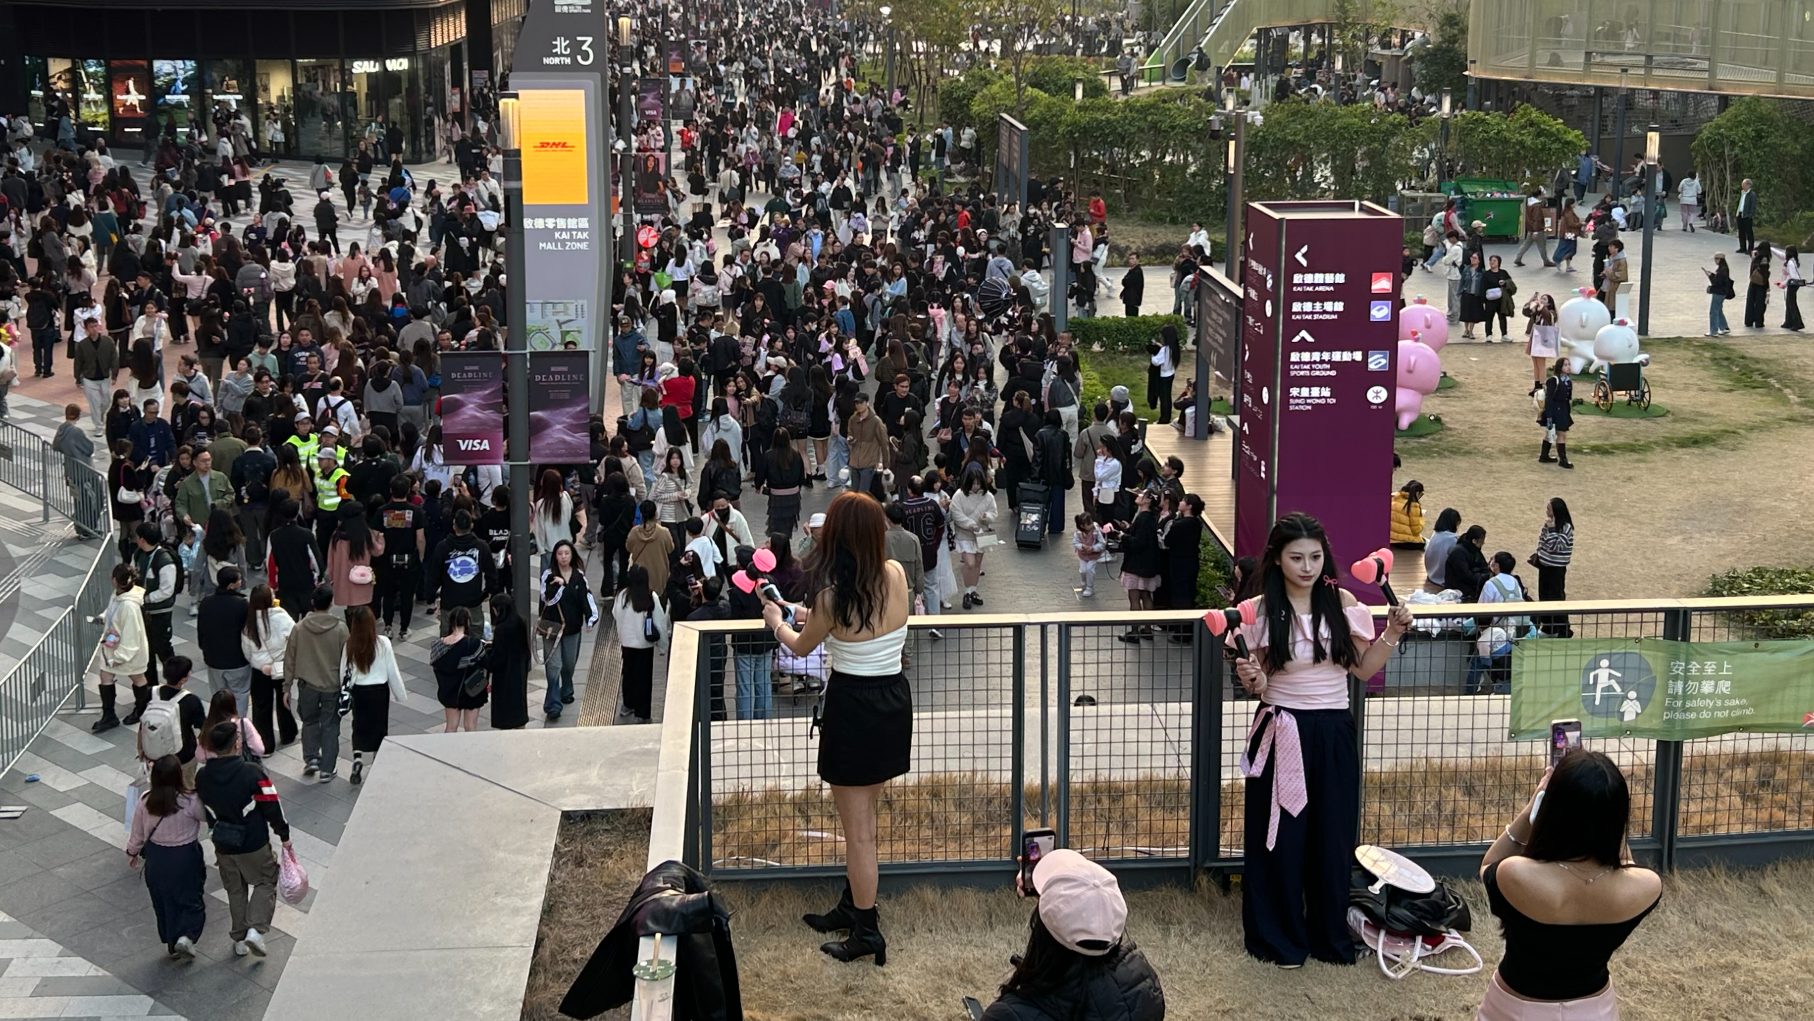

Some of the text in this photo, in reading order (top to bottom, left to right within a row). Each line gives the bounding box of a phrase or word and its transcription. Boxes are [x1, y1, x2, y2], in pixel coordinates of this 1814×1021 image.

[552, 36, 570, 55] 北
[576, 36, 594, 66] 3
[543, 57, 571, 65] NORTH
[537, 141, 569, 149] DHL
[554, 231, 589, 240] KAI TAK
[539, 242, 589, 251] MALL ZONE
[451, 371, 493, 379] DEADLINE
[534, 374, 585, 382] DEADLINE
[457, 439, 490, 451] VISA
[906, 512, 936, 541] 16
[1669, 660, 1732, 676] 安全至上
[1667, 679, 1731, 695] 請勿攀爬
[1665, 697, 1748, 709] For safety's sake,
[1663, 707, 1756, 721] please do not climb.
